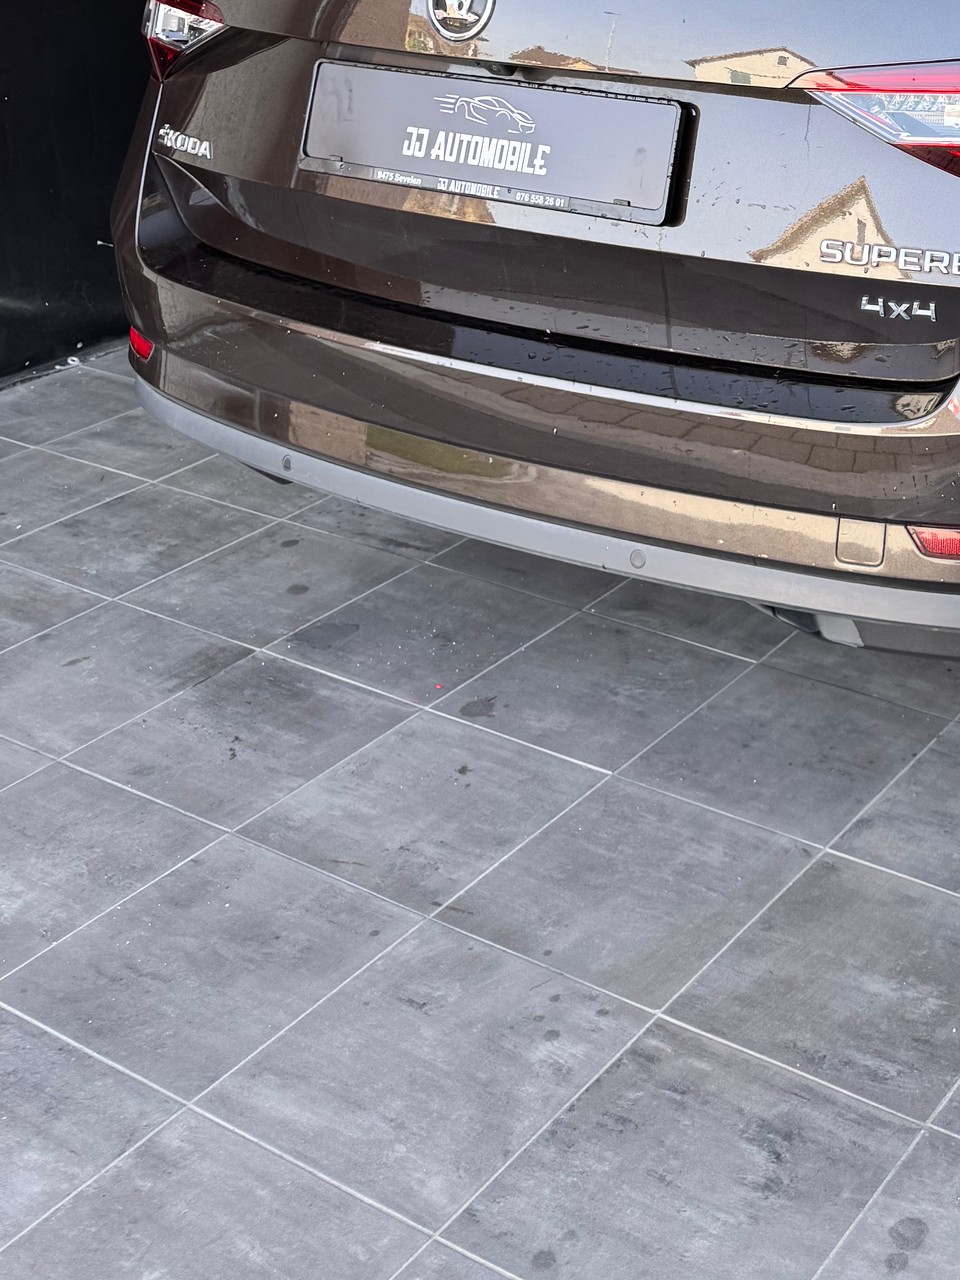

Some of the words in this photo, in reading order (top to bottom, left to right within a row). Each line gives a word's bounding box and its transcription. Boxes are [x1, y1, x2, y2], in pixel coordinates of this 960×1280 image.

[158, 123, 213, 160] ŠKODA
[402, 126, 429, 158] JJ
[430, 130, 551, 176] AUTOMOBILE
[448, 179, 501, 199] AUTOMOBILE
[515, 191, 530, 202] 076
[544, 196, 556, 206] 26
[555, 198, 565, 207] 01
